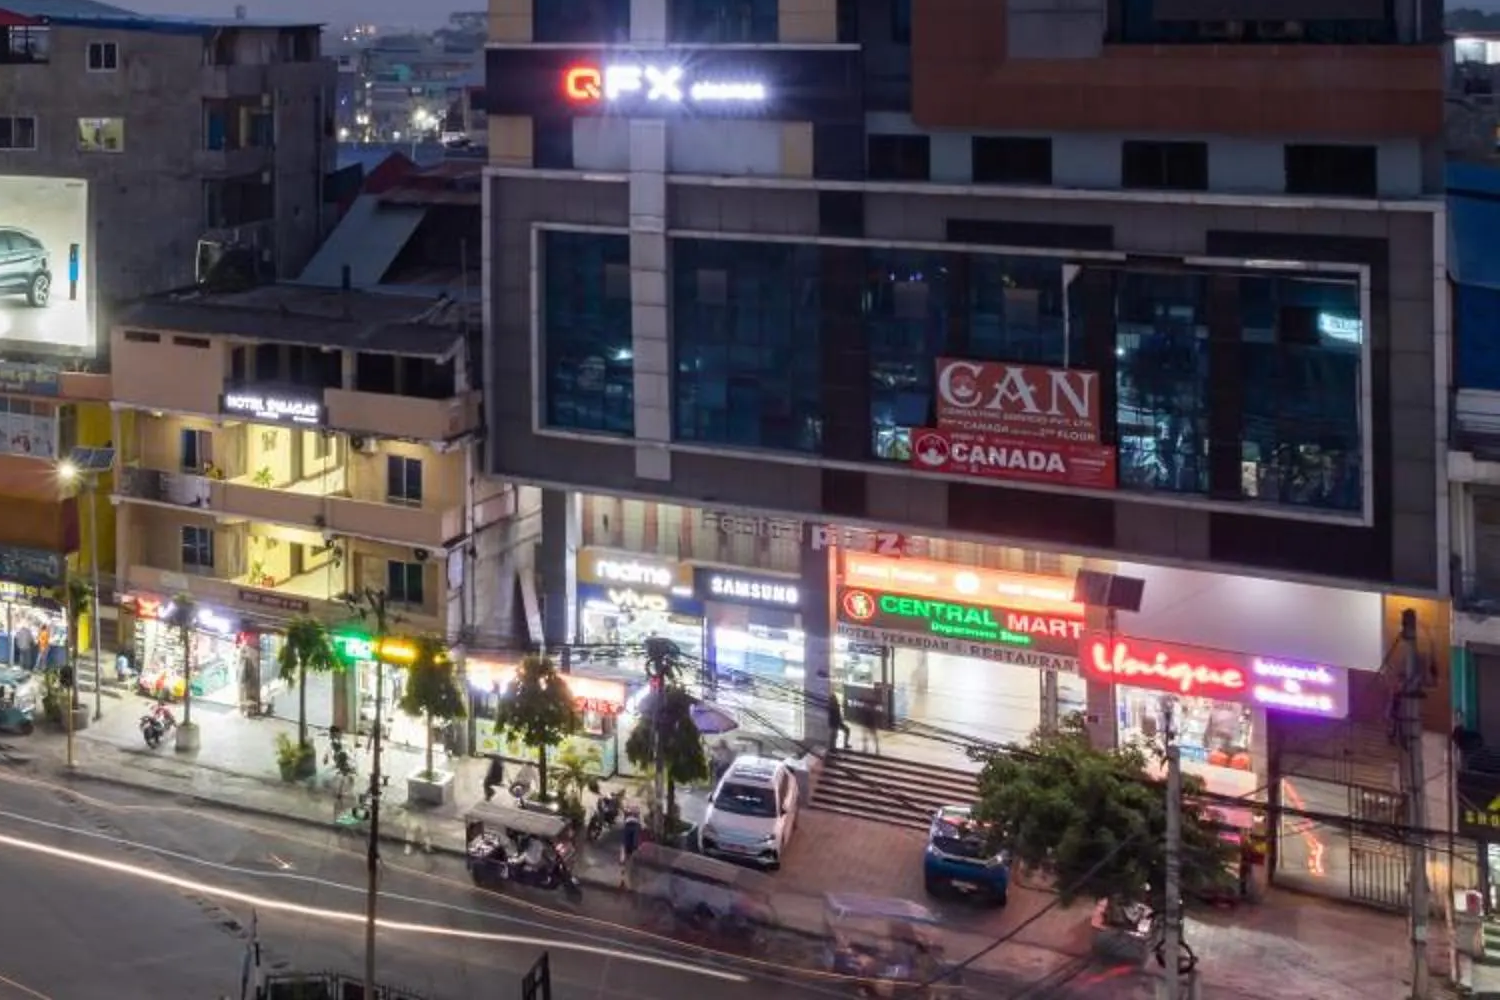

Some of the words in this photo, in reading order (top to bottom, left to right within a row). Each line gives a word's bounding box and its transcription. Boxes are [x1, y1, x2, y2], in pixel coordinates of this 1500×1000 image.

[566, 65, 682, 100] QFX
[227, 395, 264, 412] HOTEL
[938, 361, 1093, 418] CAN
[951, 444, 1066, 473] CANADA
[596, 560, 672, 588] realme
[609, 588, 668, 611] vivo
[711, 576, 799, 604] SAMSUNG
[880, 595, 998, 628] CENTRAL
[1007, 613, 1085, 640] MART
[1092, 642, 1244, 692] Unique
